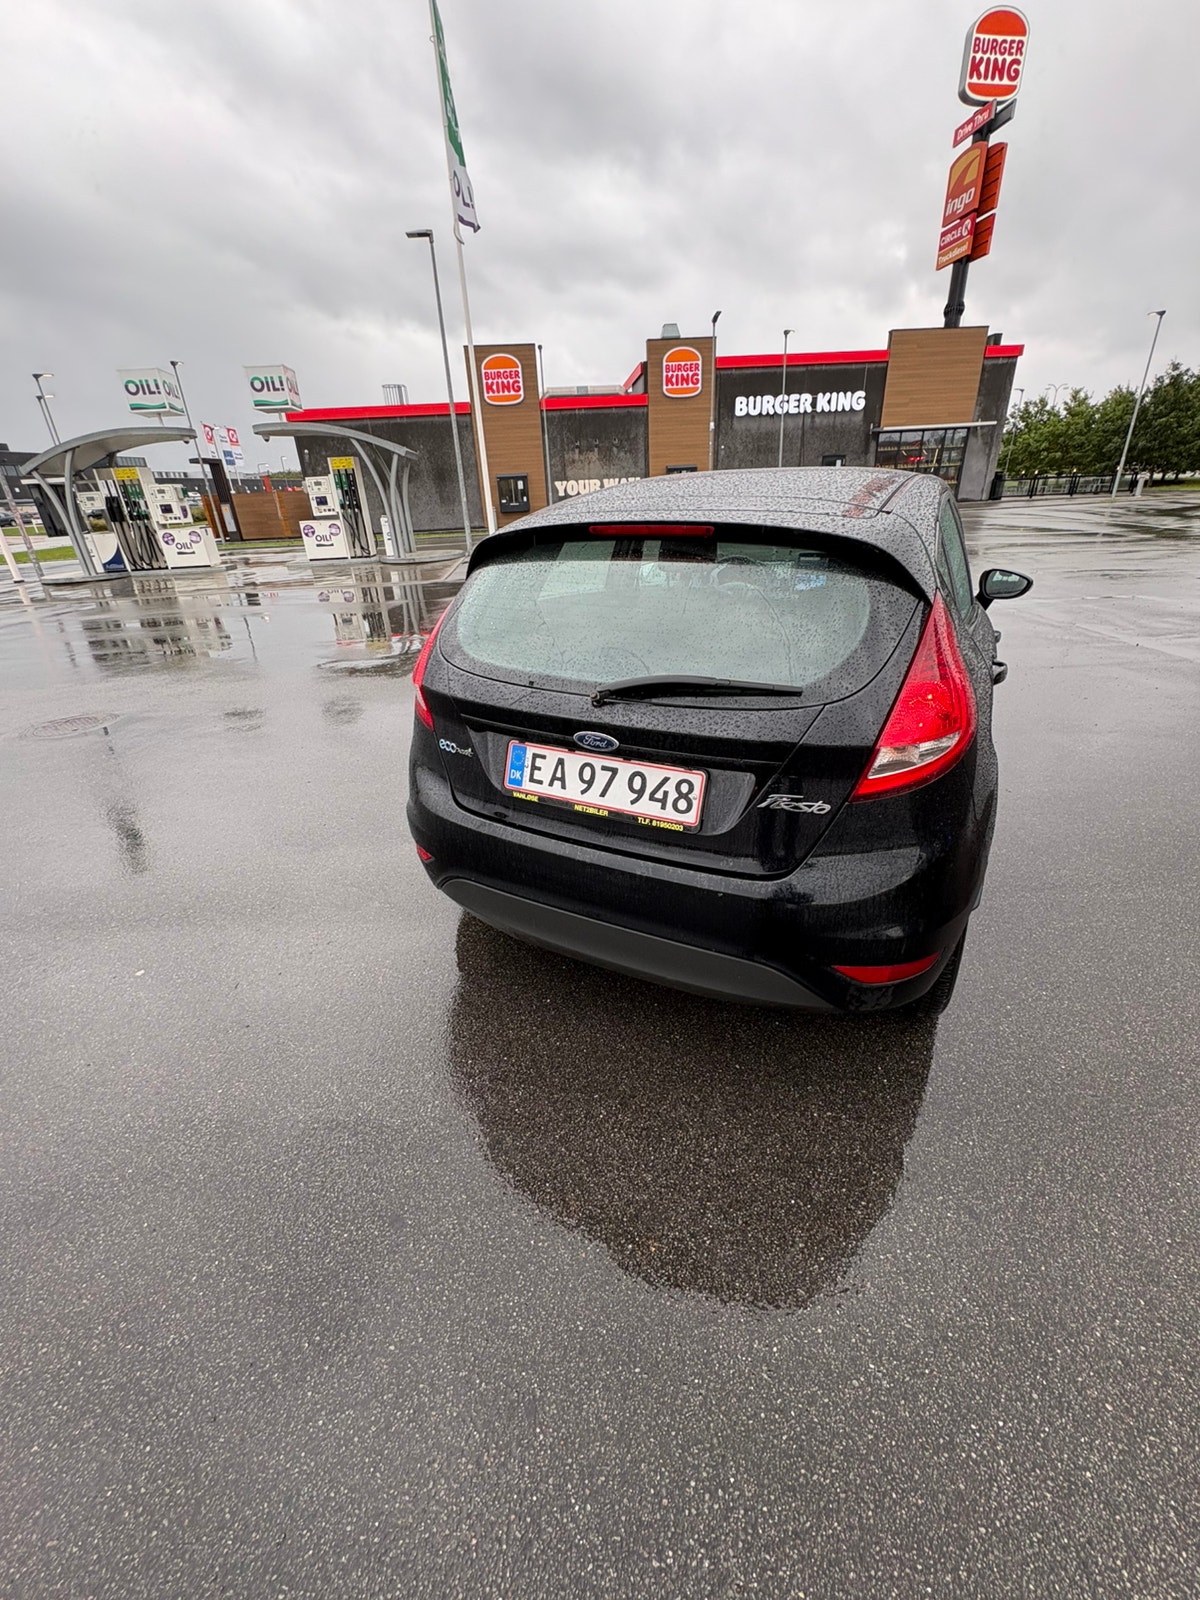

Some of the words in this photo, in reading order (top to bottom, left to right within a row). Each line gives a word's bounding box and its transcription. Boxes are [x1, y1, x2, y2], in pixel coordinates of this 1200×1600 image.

[972, 36, 1024, 57] BURGER
[969, 55, 1022, 82] KING
[957, 122, 973, 140] Drive
[974, 109, 989, 127] Thru
[945, 187, 975, 217] ingo
[940, 226, 962, 246] CIRCLE
[484, 370, 520, 380] BURGER
[665, 363, 700, 373] BURGER
[124, 379, 162, 396] OIL!
[250, 376, 285, 392] OIL!
[485, 380, 522, 395] KING
[665, 373, 700, 387] KING
[162, 379, 180, 399] OIL!
[734, 393, 813, 417] BURGER
[816, 390, 866, 413] KING
[554, 479, 601, 497] YOUR
[175, 542, 193, 550] OIL!
[313, 534, 332, 543] OIL!
[583, 734, 607, 748] Ford
[510, 769, 522, 781] DK
[528, 752, 567, 790] EA
[577, 762, 619, 798] 97
[627, 770, 695, 815] 948
[756, 793, 832, 820] Fiesta
[637, 816, 651, 826] TLF.
